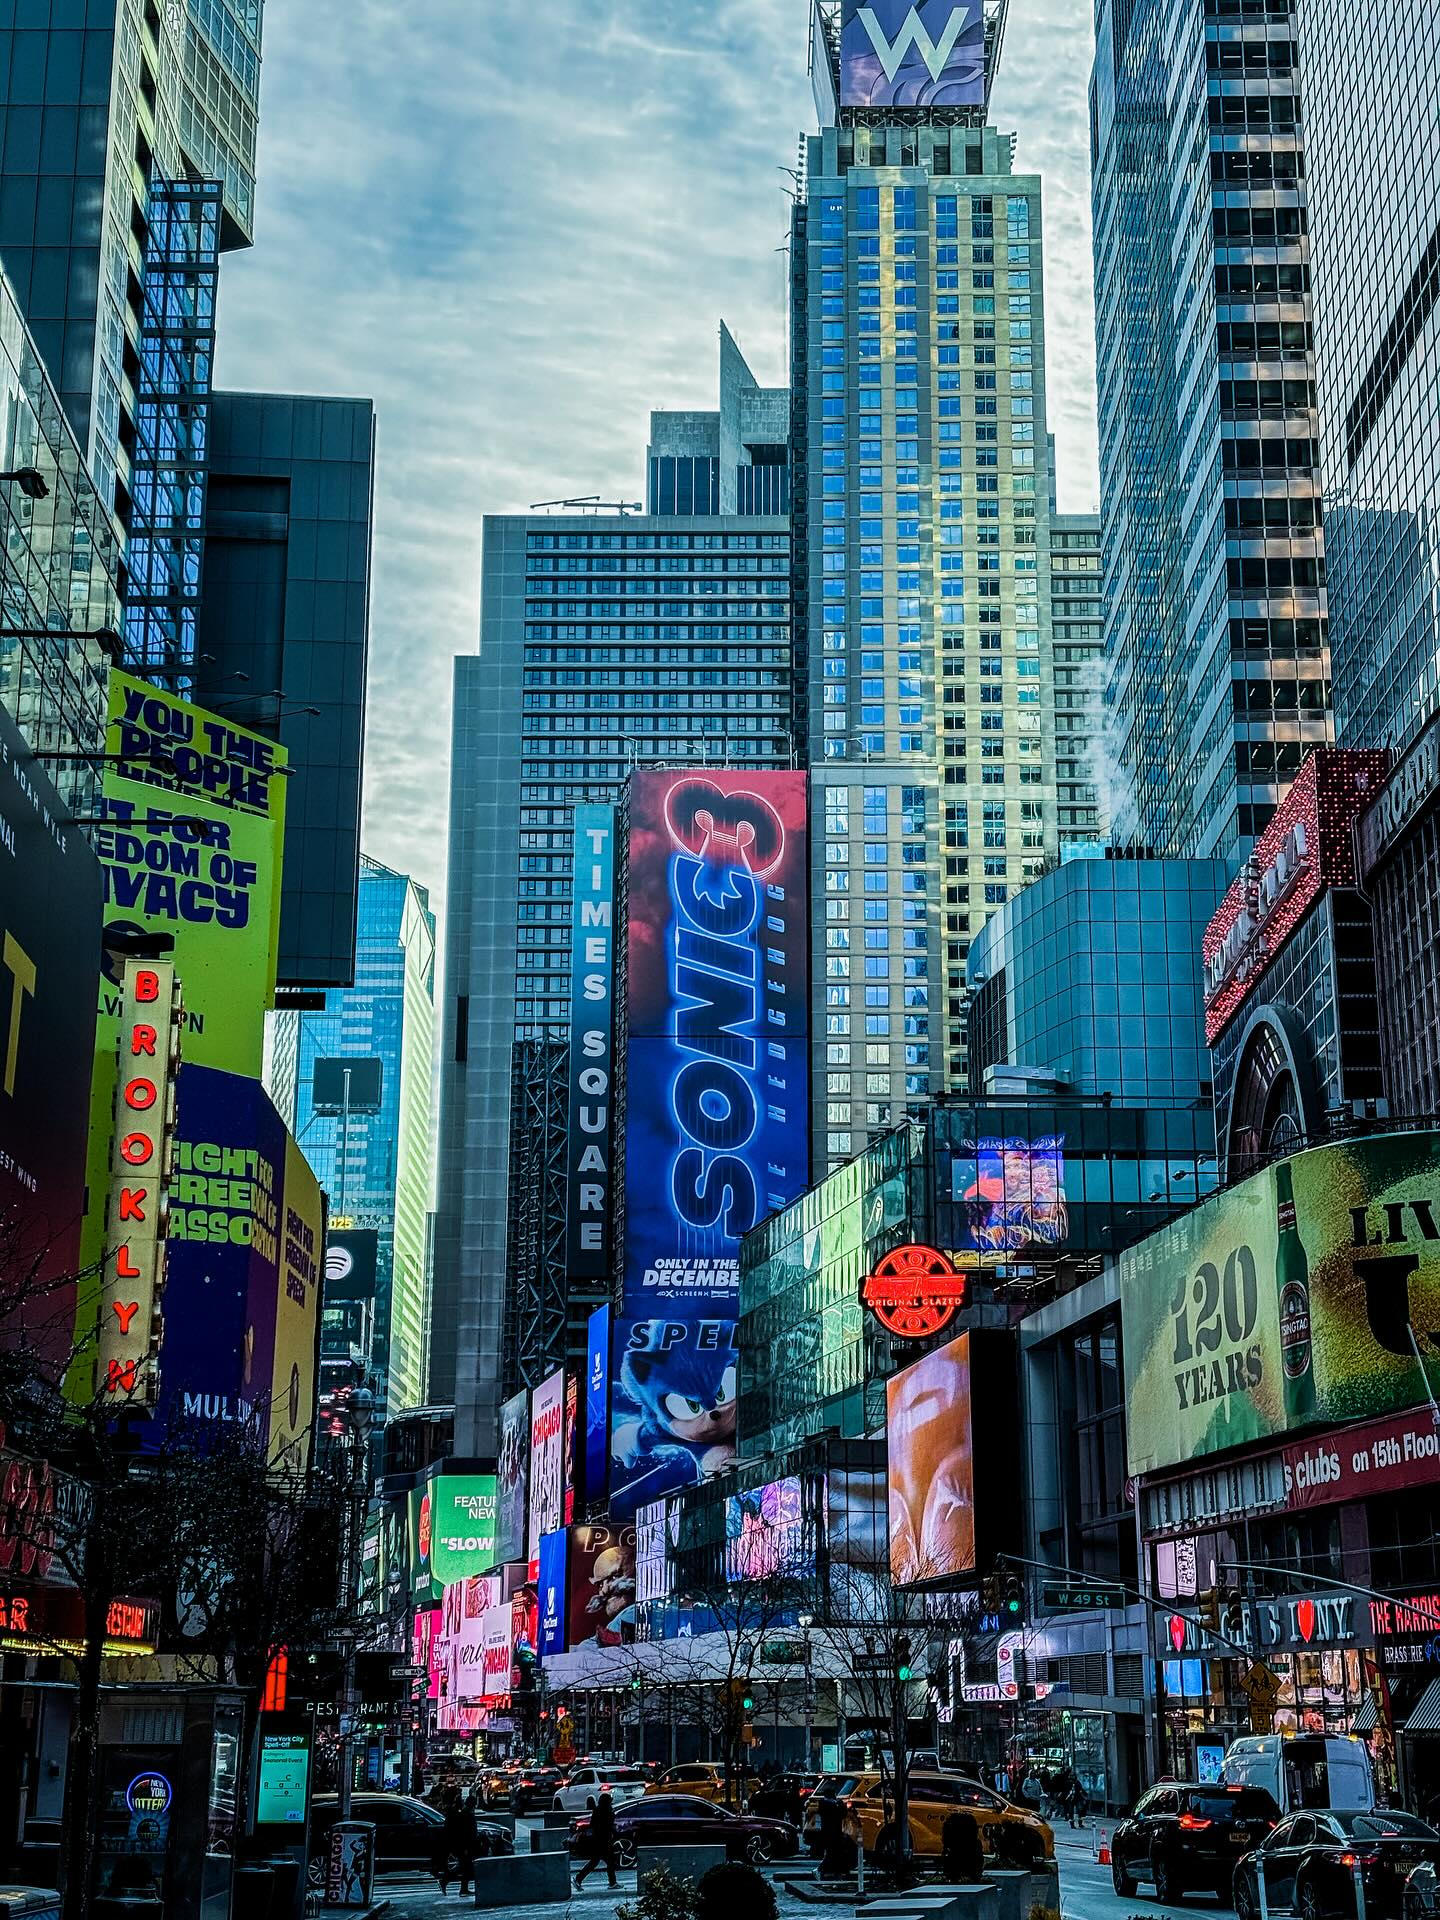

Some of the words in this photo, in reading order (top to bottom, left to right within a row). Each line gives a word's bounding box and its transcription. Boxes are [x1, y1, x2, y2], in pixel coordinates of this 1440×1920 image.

[856, 5, 969, 83] W
[123, 686, 194, 743] YOU
[203, 721, 274, 773] THE
[120, 726, 269, 811] PEOPLE
[13, 759, 40, 812] NOAH
[43, 805, 67, 855] WYLE
[146, 807, 231, 850] FOR
[209, 853, 257, 888] OF
[580, 829, 611, 1001] TIMES
[767, 883, 786, 1123] HEDGEHOG
[672, 855, 758, 1240] SONIC
[577, 1030, 609, 1251] SQUARE
[17, 1165, 37, 1193] WING
[108, 970, 160, 1394] BROOKLYN
[654, 1258, 691, 1270] ONLY
[693, 1259, 710, 1270] IN
[890, 1250, 937, 1273] HOT
[867, 1297, 919, 1307] ORIGINAL
[921, 1296, 963, 1307] GLAZED
[889, 1307, 939, 1328] NOW
[1170, 1243, 1259, 1365] 120
[1173, 1342, 1265, 1411] YEARS
[533, 1403, 561, 1449] CHICAGO
[1296, 1447, 1341, 1490] clubs
[1352, 1455, 1369, 1474] on
[1372, 1434, 1401, 1470] 15th
[1058, 1593, 1069, 1605] W
[1073, 1594, 1091, 1605] 49
[1095, 1595, 1110, 1606] St
[1368, 1599, 1393, 1635] THE
[292, 1735, 305, 1744] City
[150, 1778, 164, 1788] NEW
[150, 1788, 166, 1798] YORK
